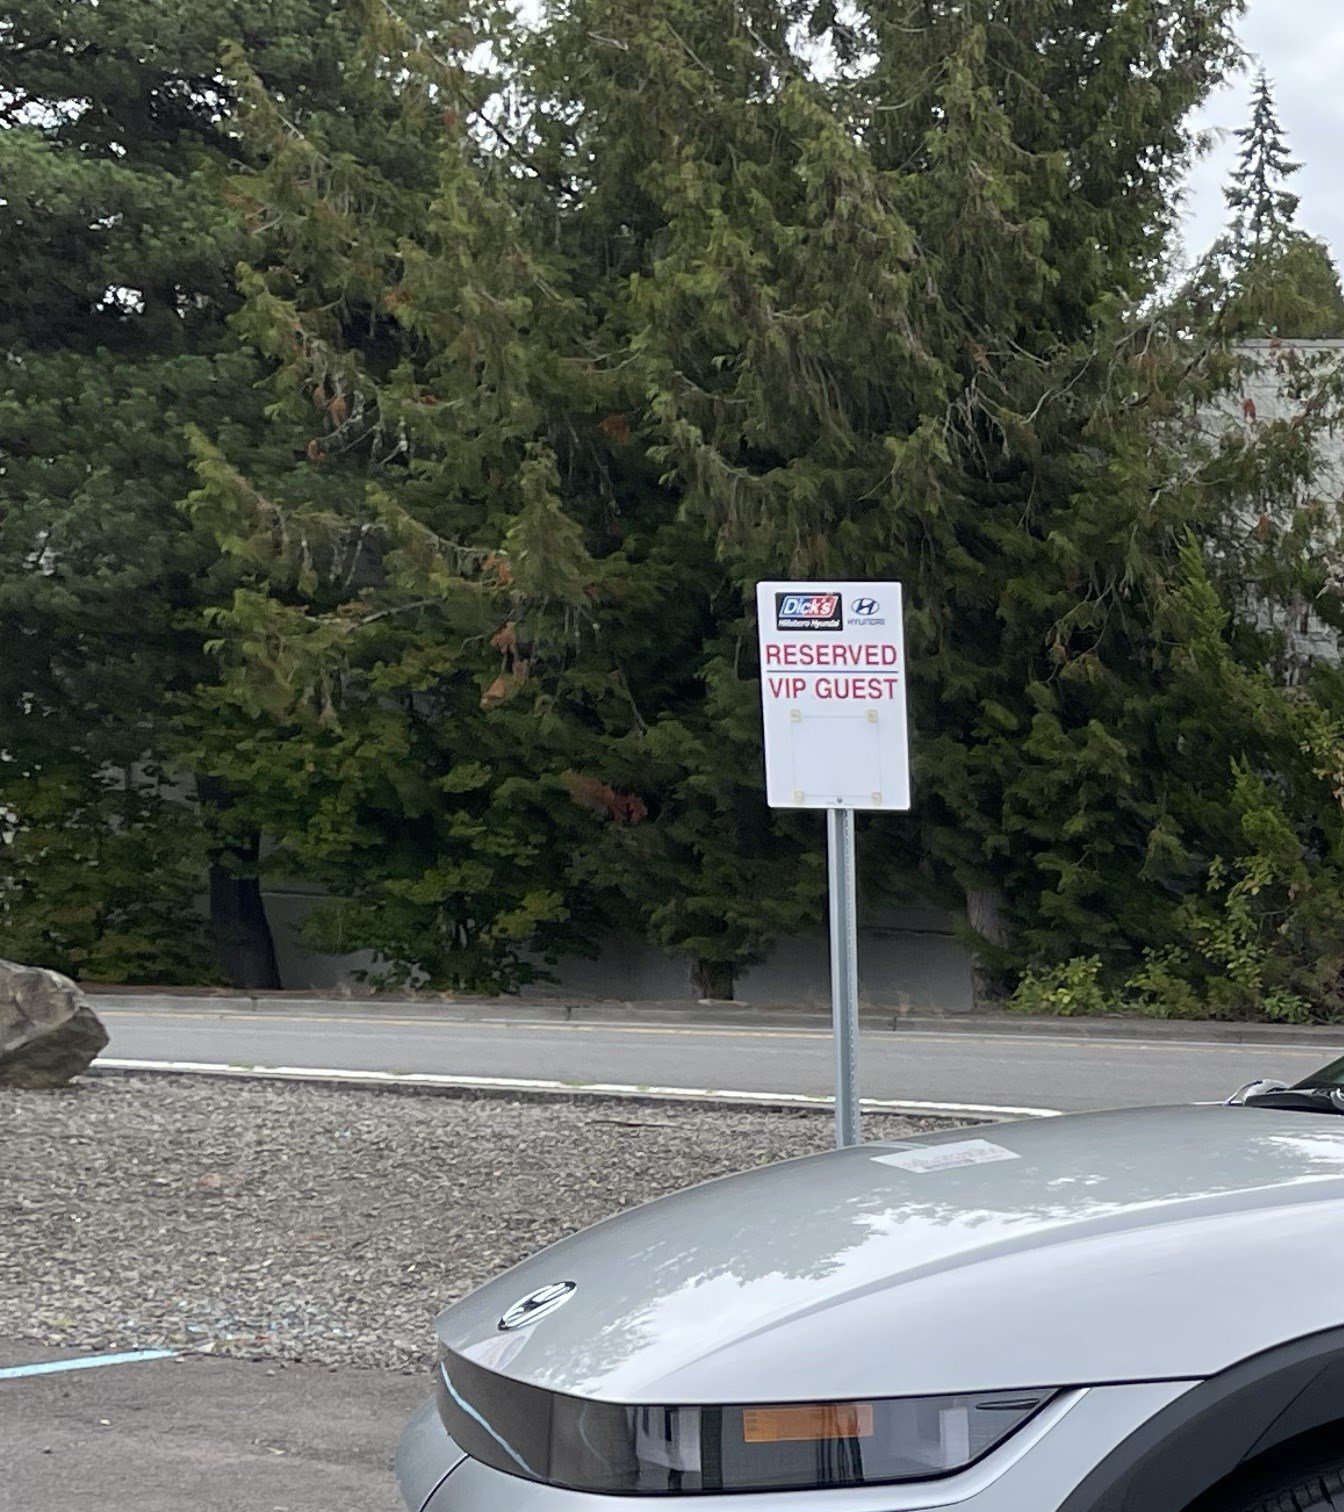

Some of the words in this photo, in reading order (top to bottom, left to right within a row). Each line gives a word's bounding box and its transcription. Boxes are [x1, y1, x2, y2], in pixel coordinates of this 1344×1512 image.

[766, 644, 898, 665] RESERVED
[768, 677, 807, 700] VIP
[815, 677, 899, 700] GUEST
